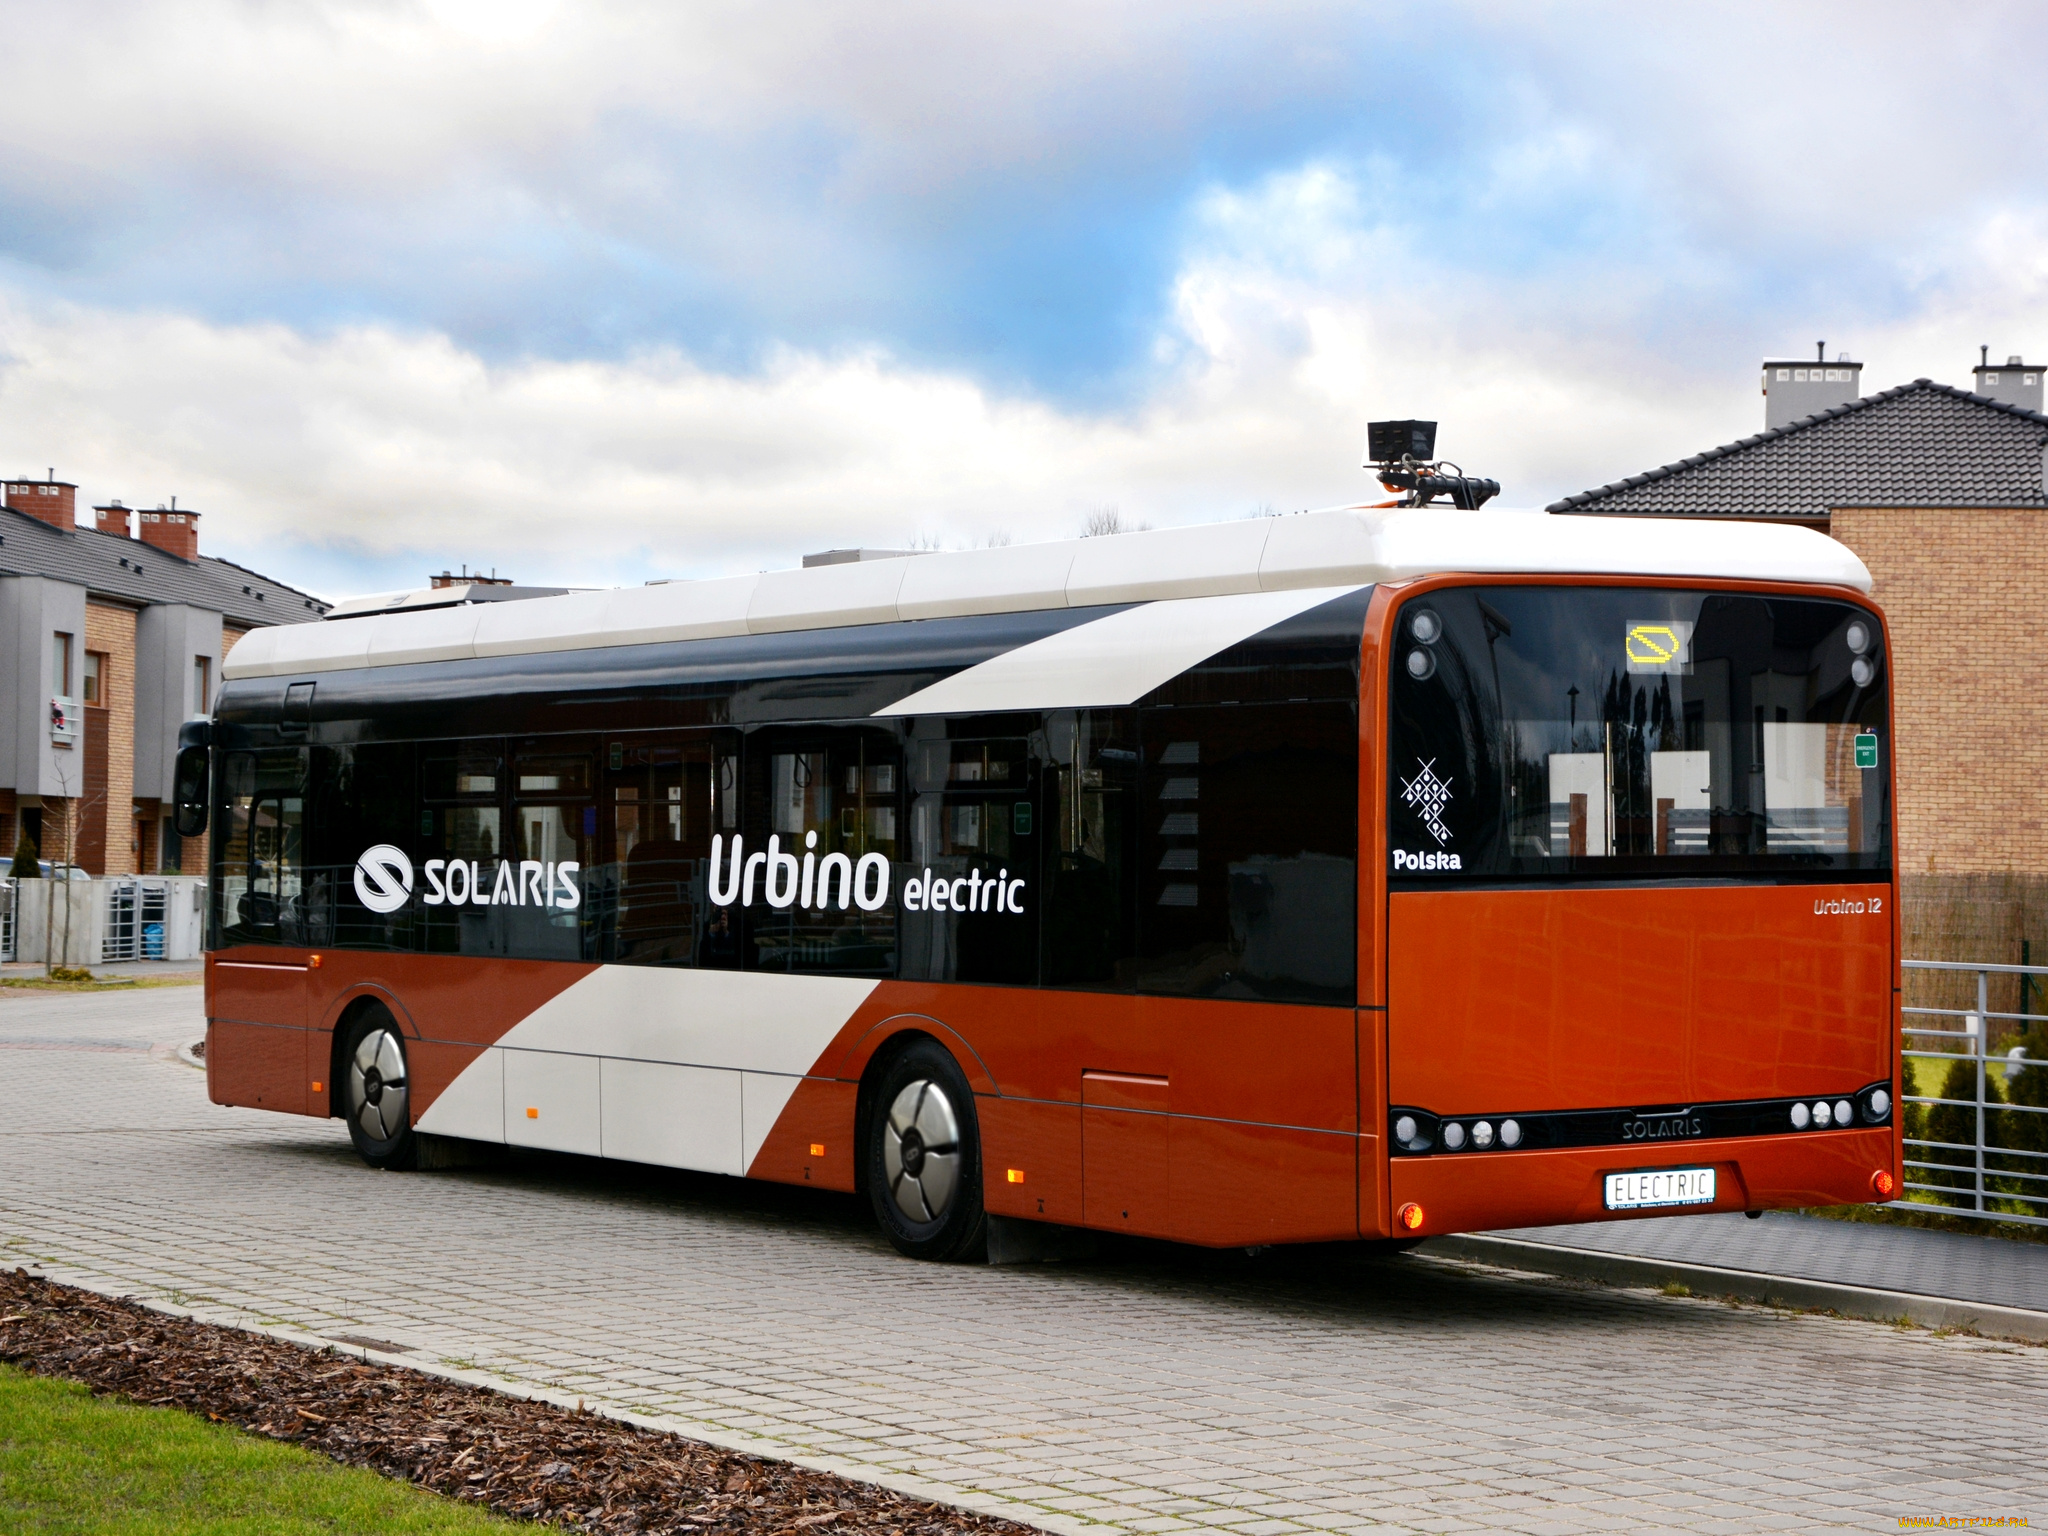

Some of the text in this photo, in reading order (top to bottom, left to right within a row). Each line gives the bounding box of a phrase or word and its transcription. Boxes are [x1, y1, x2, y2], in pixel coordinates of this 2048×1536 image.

[708, 830, 1026, 914] Urbino electric
[1392, 849, 1462, 870] Polska
[423, 858, 581, 909] SOLARIS
[1814, 897, 1882, 915] Urbino 12
[1622, 1118, 1701, 1139] SOLARIS
[1615, 1173, 1707, 1202] ELECTRIC
